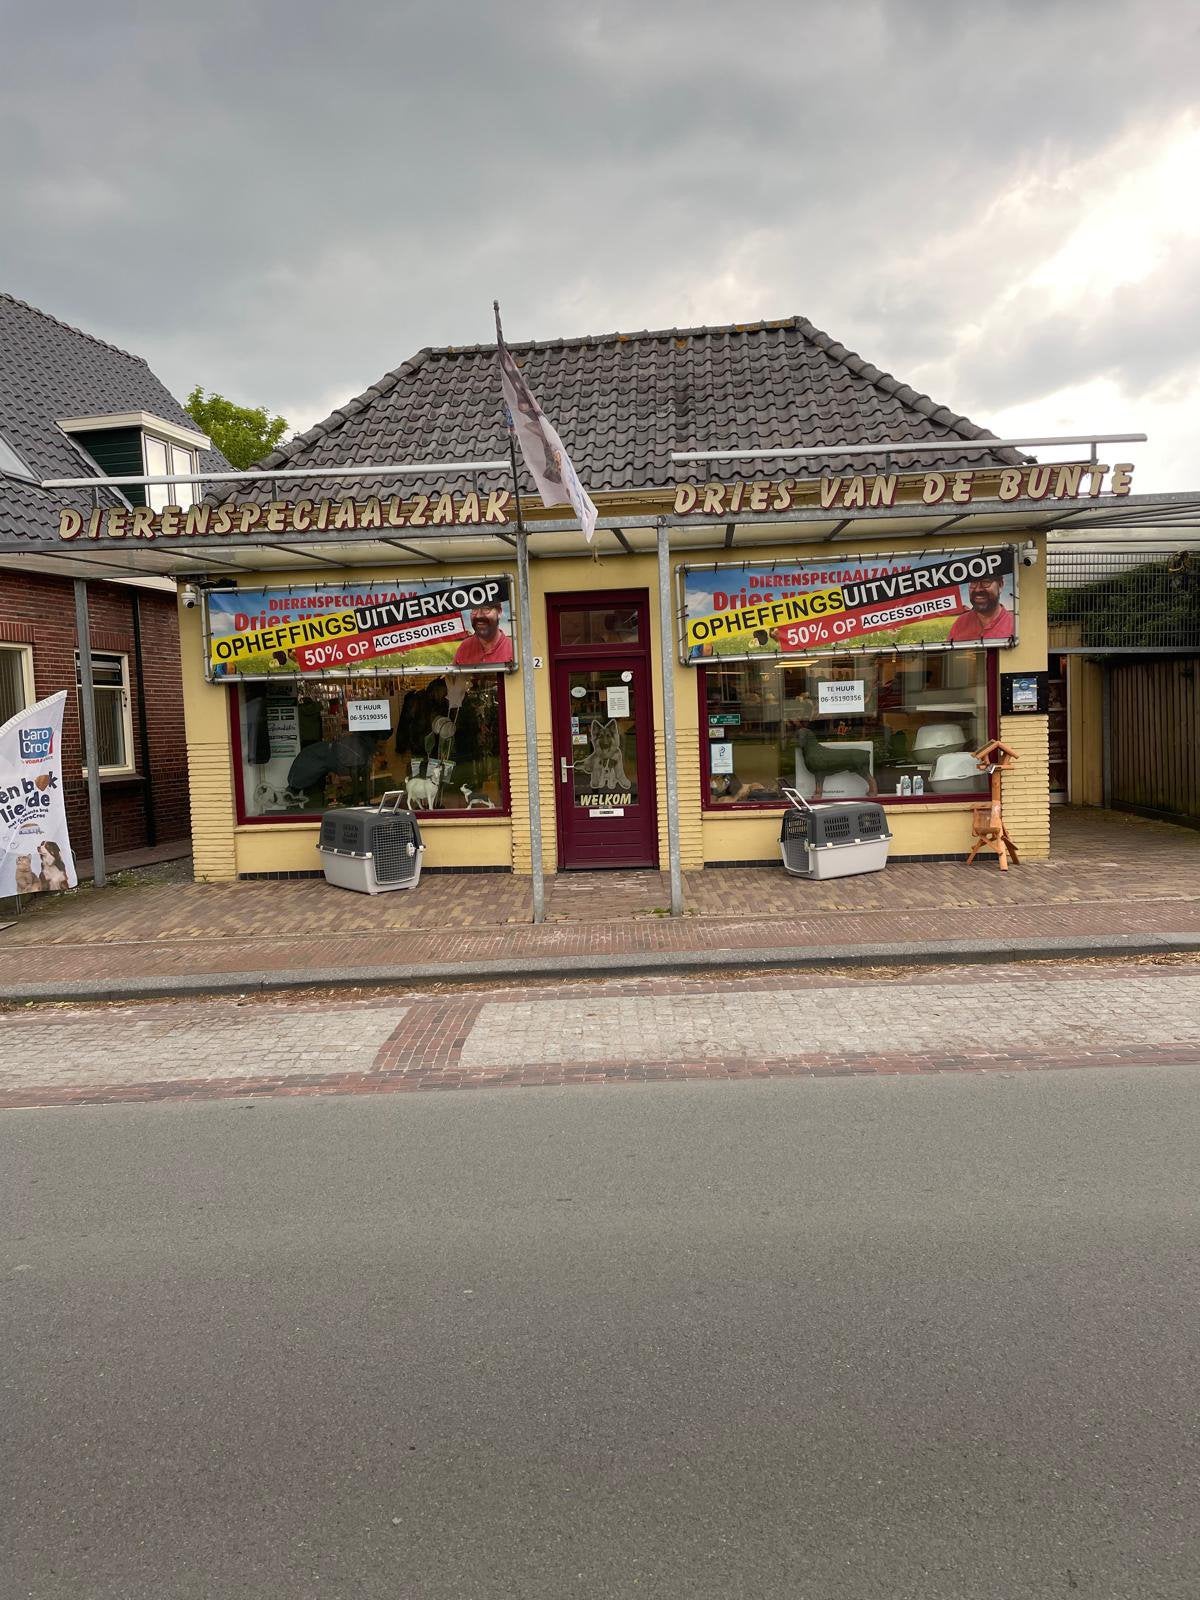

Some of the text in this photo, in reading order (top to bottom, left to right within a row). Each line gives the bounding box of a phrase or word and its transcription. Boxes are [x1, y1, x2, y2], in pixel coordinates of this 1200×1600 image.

[673, 463, 1135, 517] DRIES VAN DE BUNTE
[58, 490, 511, 541] DIERENSPECIAALZAAK
[787, 598, 952, 646] 50% OP ACCESSOIRES
[304, 621, 456, 666] 50% OP ACCESSOIRES
[534, 658, 541, 667] 2
[22, 729, 49, 741] Caro
[22, 741, 49, 753] Croc
[580, 793, 631, 806] WELKOM
